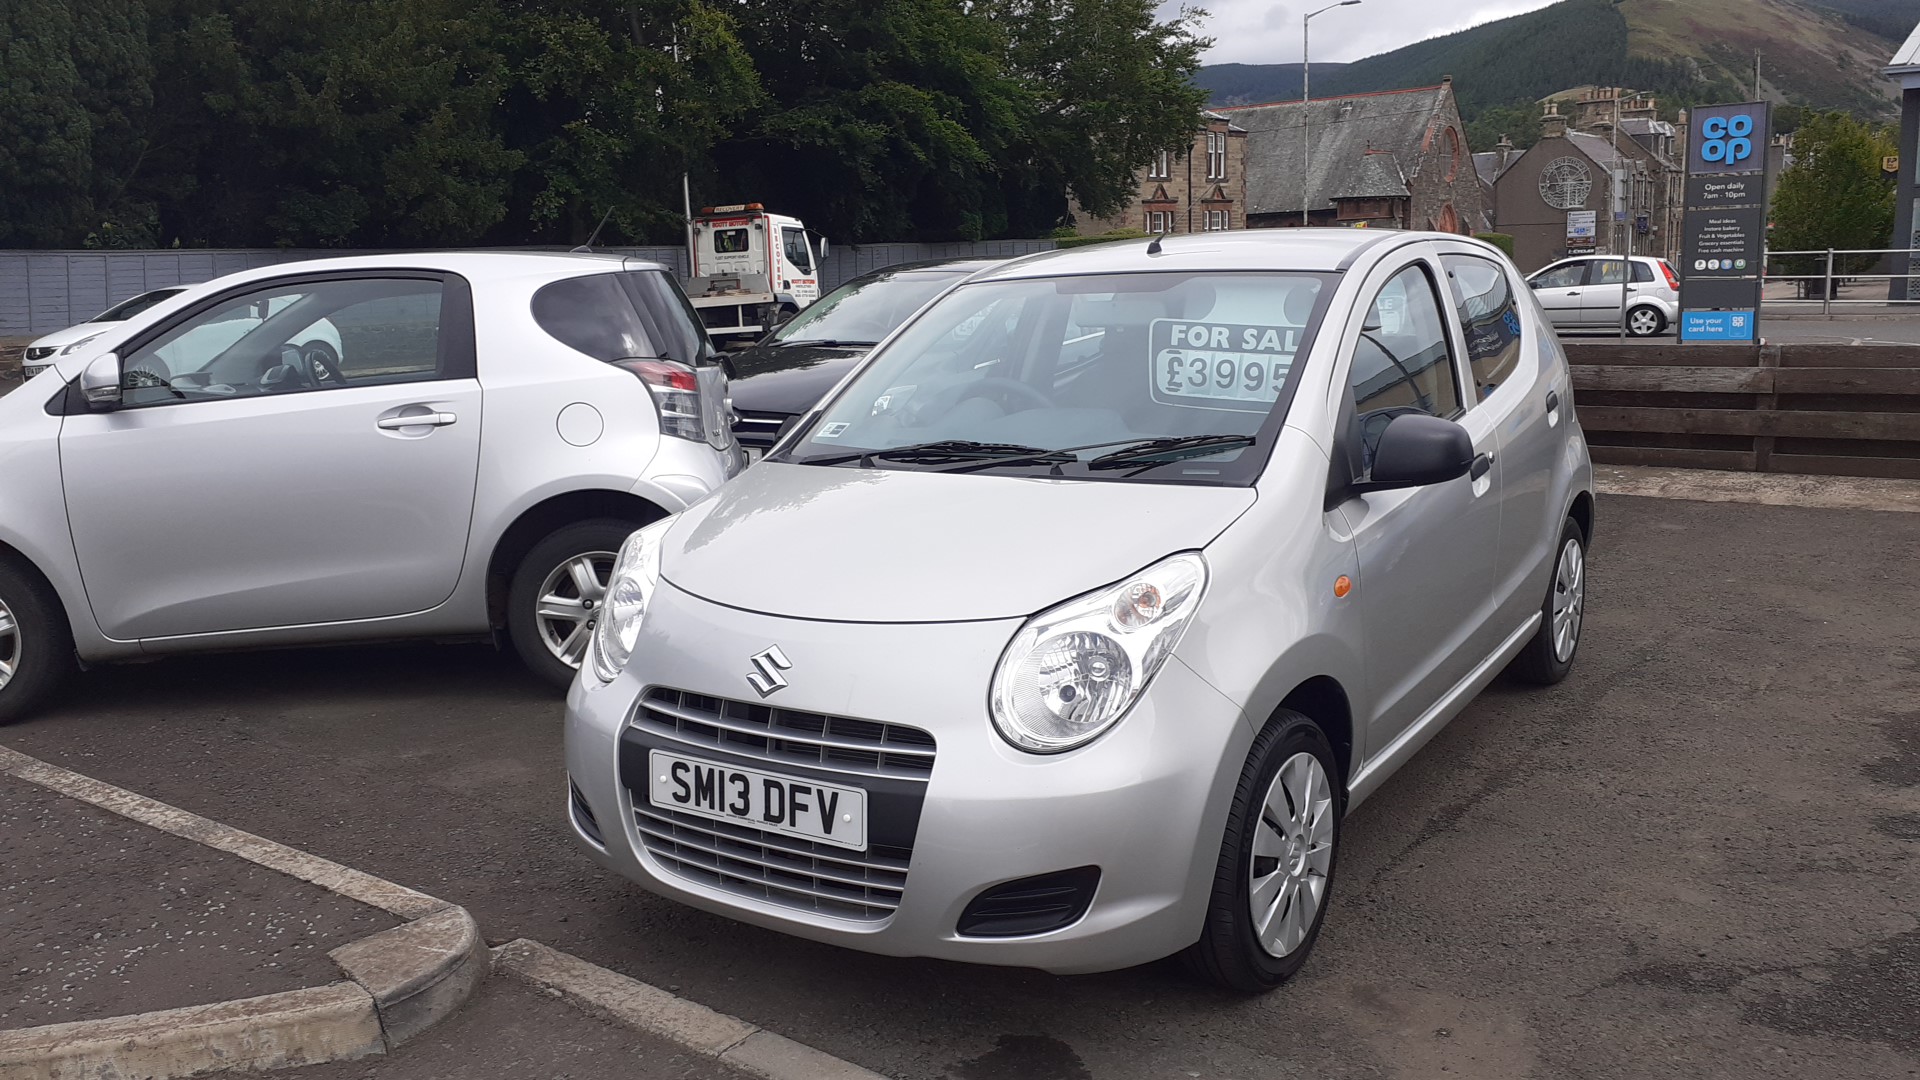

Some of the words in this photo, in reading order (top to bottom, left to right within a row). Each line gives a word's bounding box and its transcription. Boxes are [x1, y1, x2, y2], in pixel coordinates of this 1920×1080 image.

[1704, 183, 1726, 191] Open
[1727, 182, 1745, 190] daily
[1725, 191, 1746, 199] 10pm
[774, 227, 782, 289] RECOVERY
[1170, 324, 1230, 349] FOR
[1242, 328, 1299, 352] SAL
[1688, 325, 1705, 333] card
[1706, 325, 1723, 333] here
[1166, 356, 1292, 392] £3995
[671, 760, 750, 817] SM13
[763, 778, 839, 835] DFV
